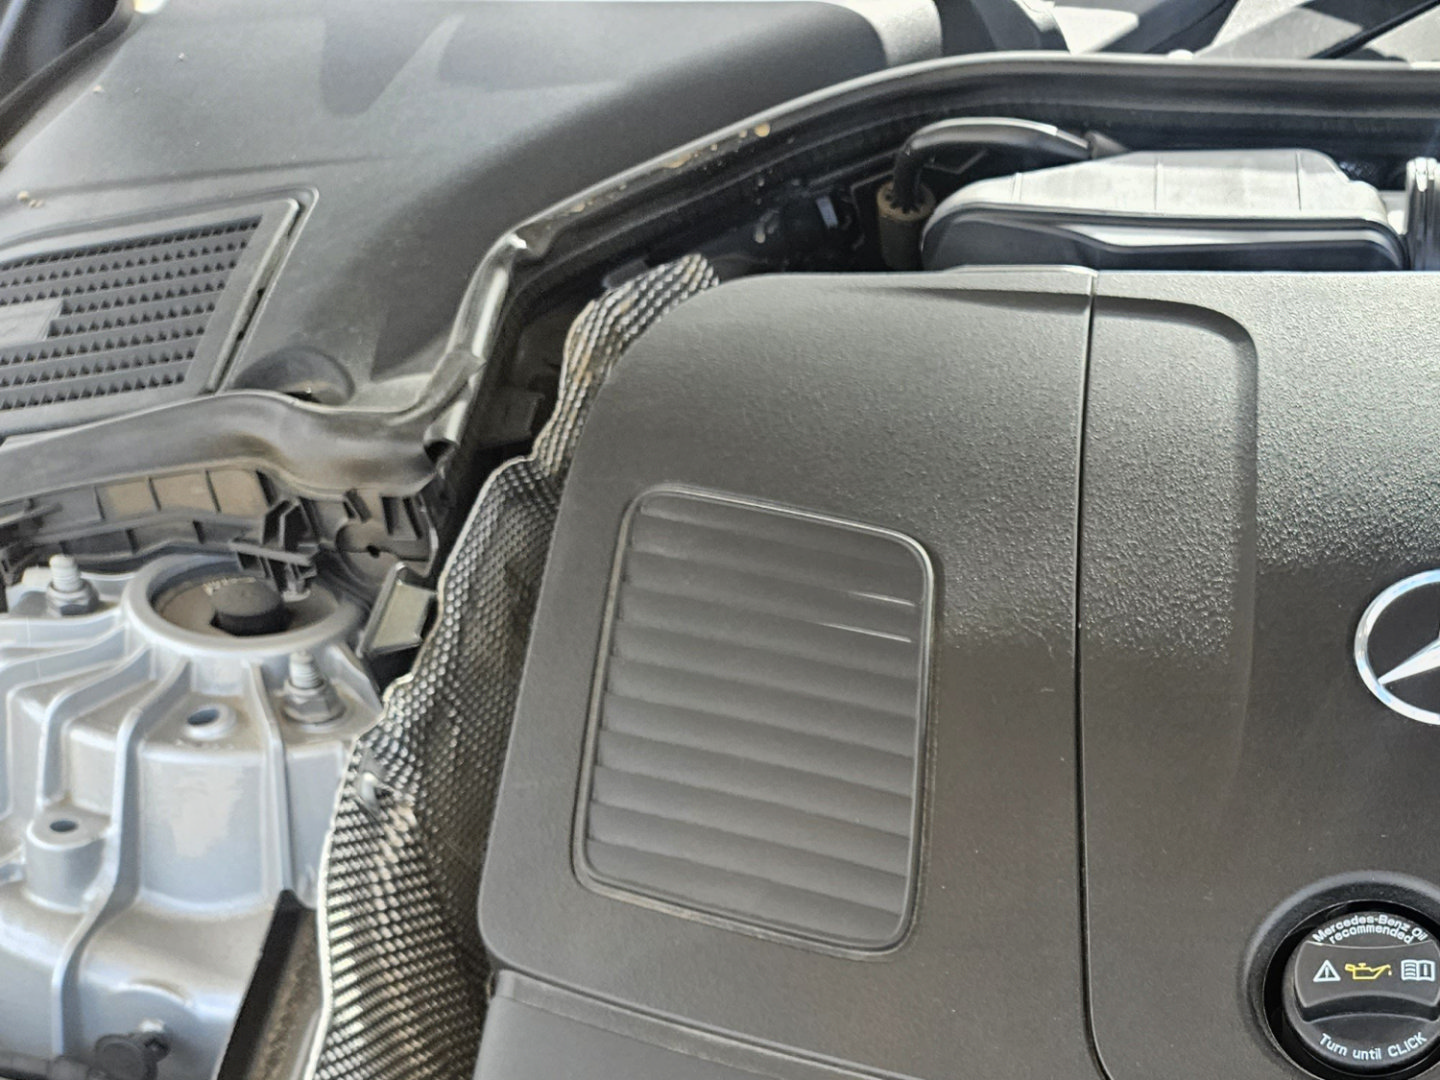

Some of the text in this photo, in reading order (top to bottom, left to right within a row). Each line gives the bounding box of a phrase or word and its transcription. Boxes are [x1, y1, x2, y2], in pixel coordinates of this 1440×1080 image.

[1312, 914, 1429, 942] Mercedes-Benz Oil
[1329, 924, 1414, 945] recommended
[1319, 1031, 1428, 1060] Turn until CLICK
